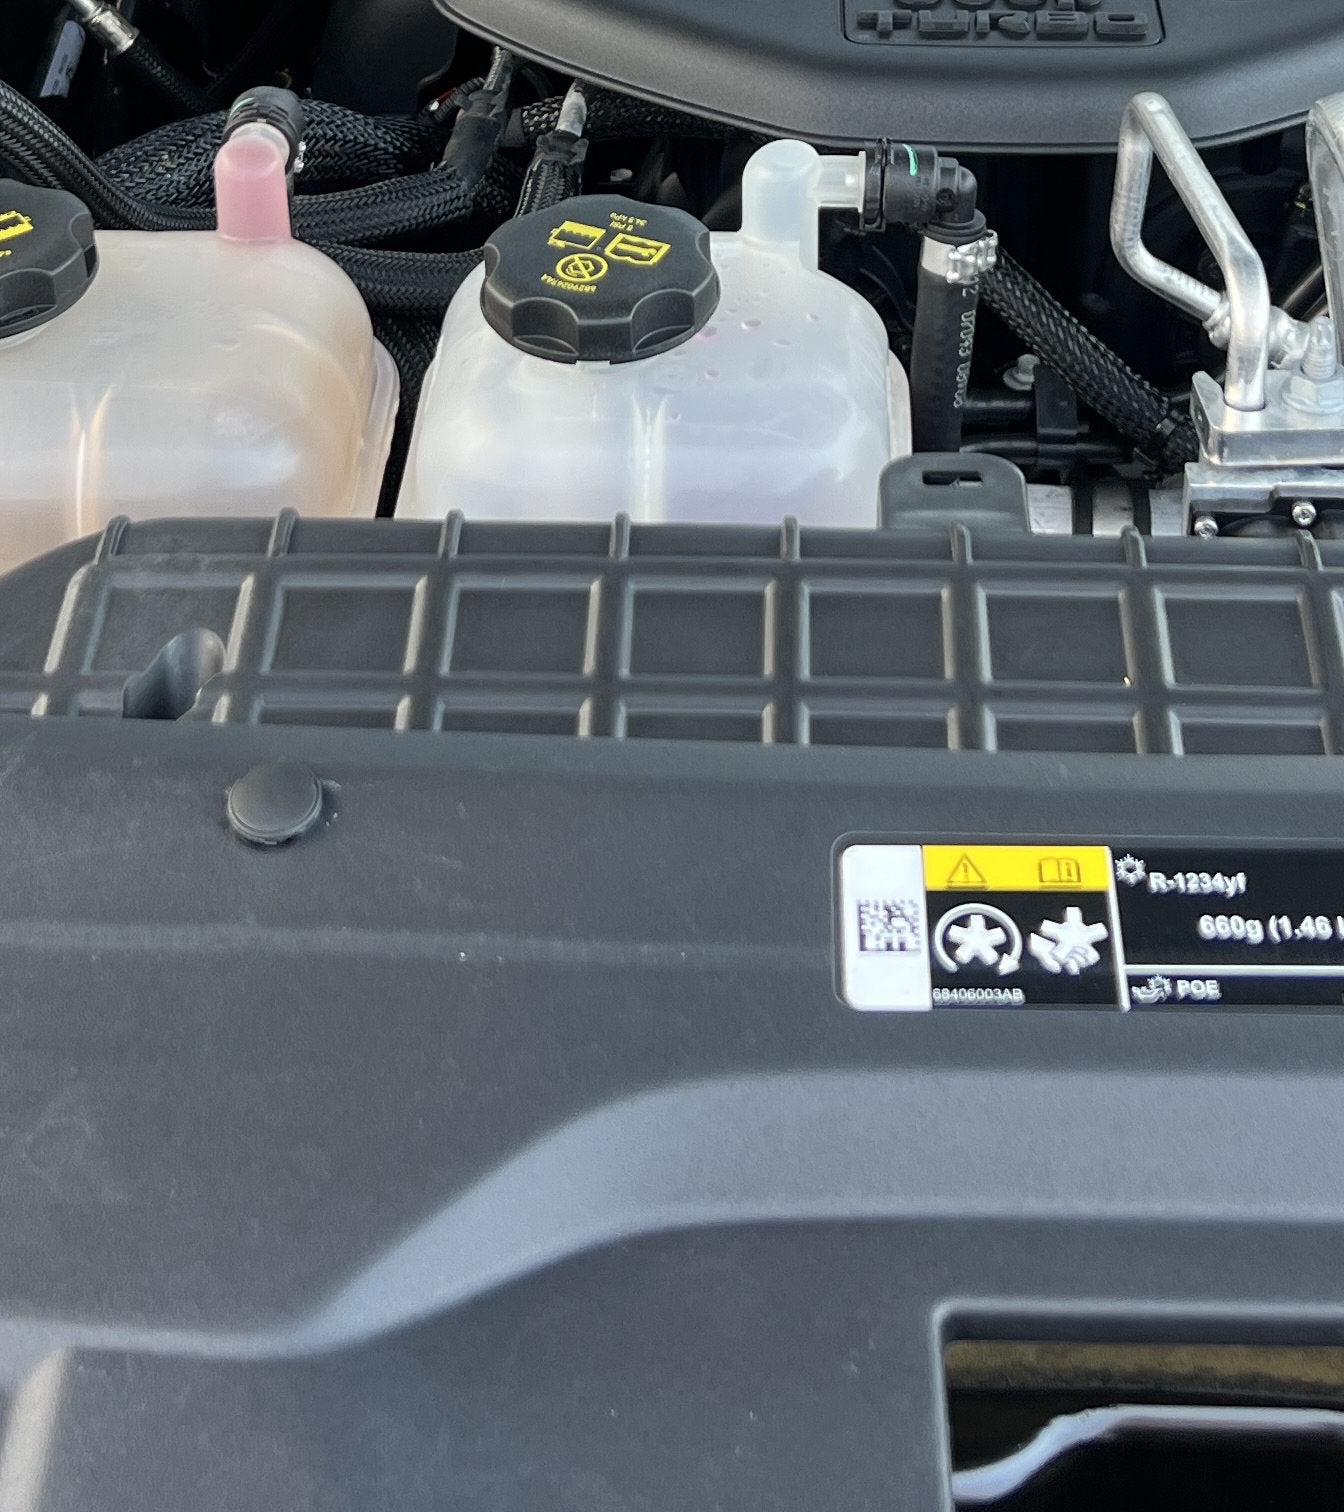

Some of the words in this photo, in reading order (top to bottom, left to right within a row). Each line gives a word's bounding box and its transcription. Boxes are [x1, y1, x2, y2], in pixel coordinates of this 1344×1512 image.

[856, 8, 1151, 40] TURBO
[1149, 872, 1247, 899] R-1234yf
[1198, 915, 1264, 944] 660g
[1268, 915, 1333, 943] (1.46
[932, 987, 1025, 1005] 68406003AB
[1176, 979, 1222, 1000] POE
